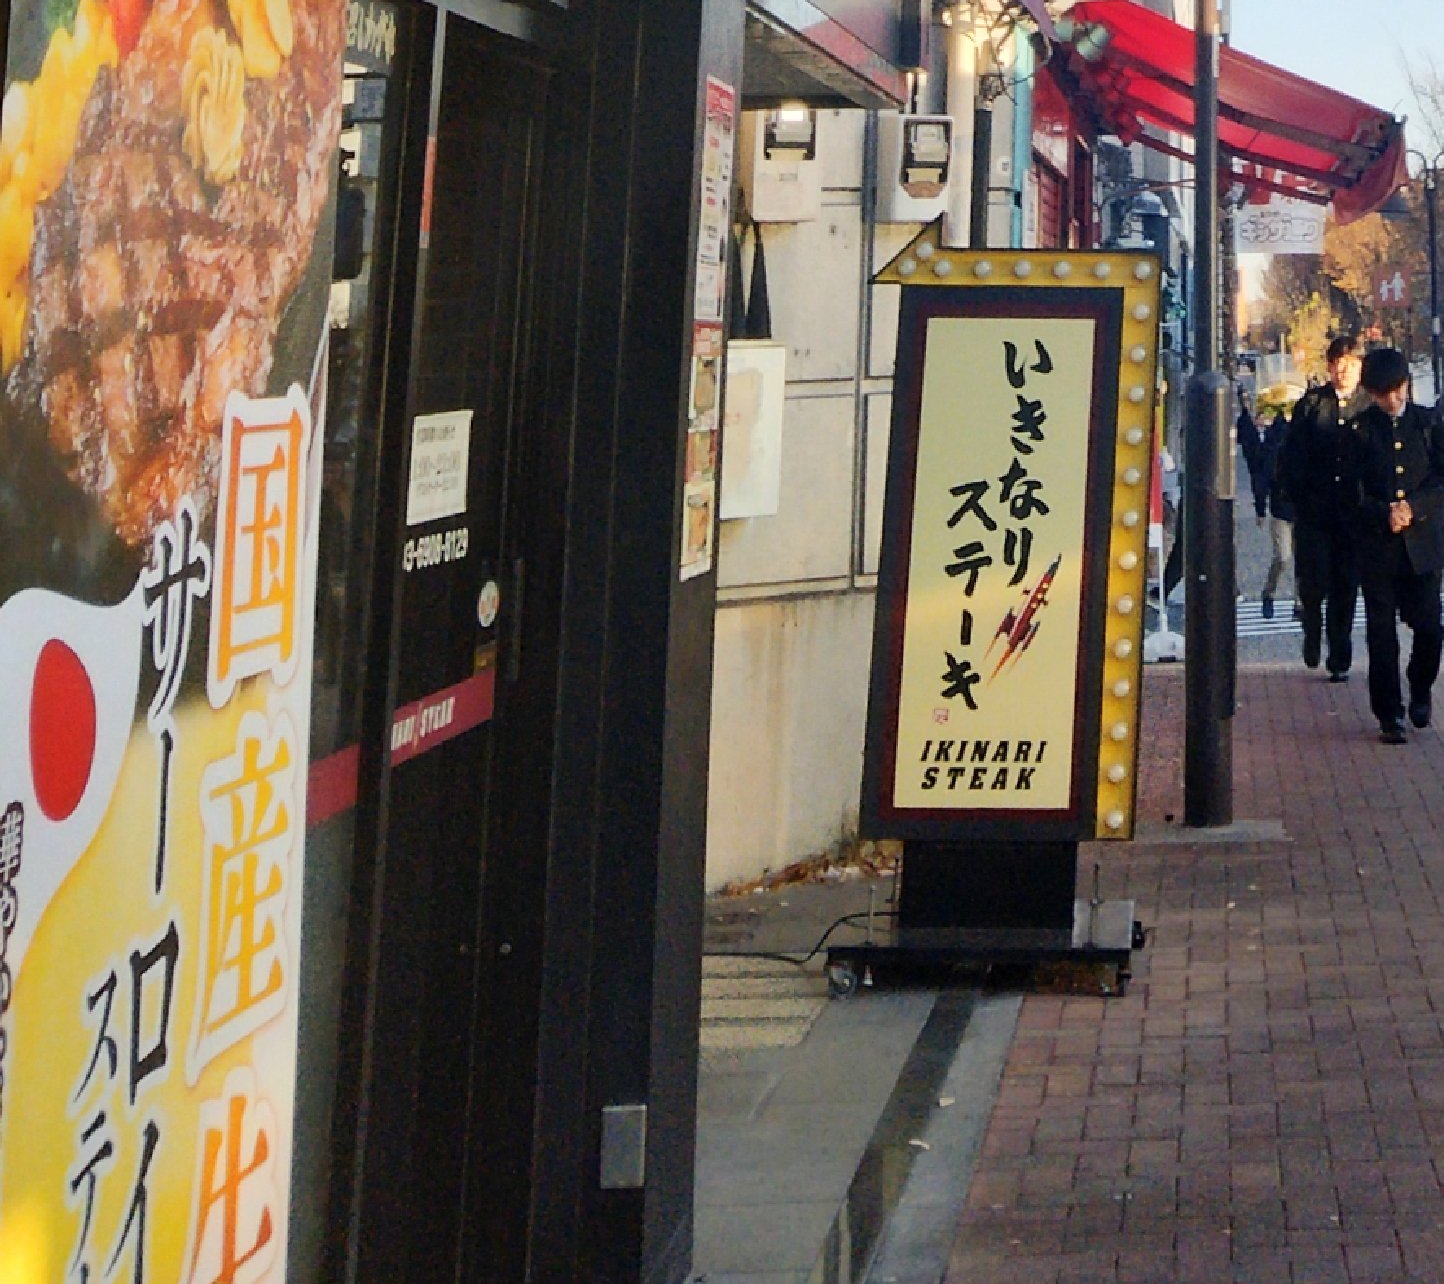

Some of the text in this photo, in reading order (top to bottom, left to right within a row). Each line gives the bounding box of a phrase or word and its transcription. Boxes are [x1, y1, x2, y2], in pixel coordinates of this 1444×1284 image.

[997, 338, 1054, 587] いきなり
[940, 479, 998, 711] ステーキ
[920, 740, 1048, 763] IKINARI
[921, 766, 1037, 790] STEAK
[69, 969, 117, 1284] ステ
